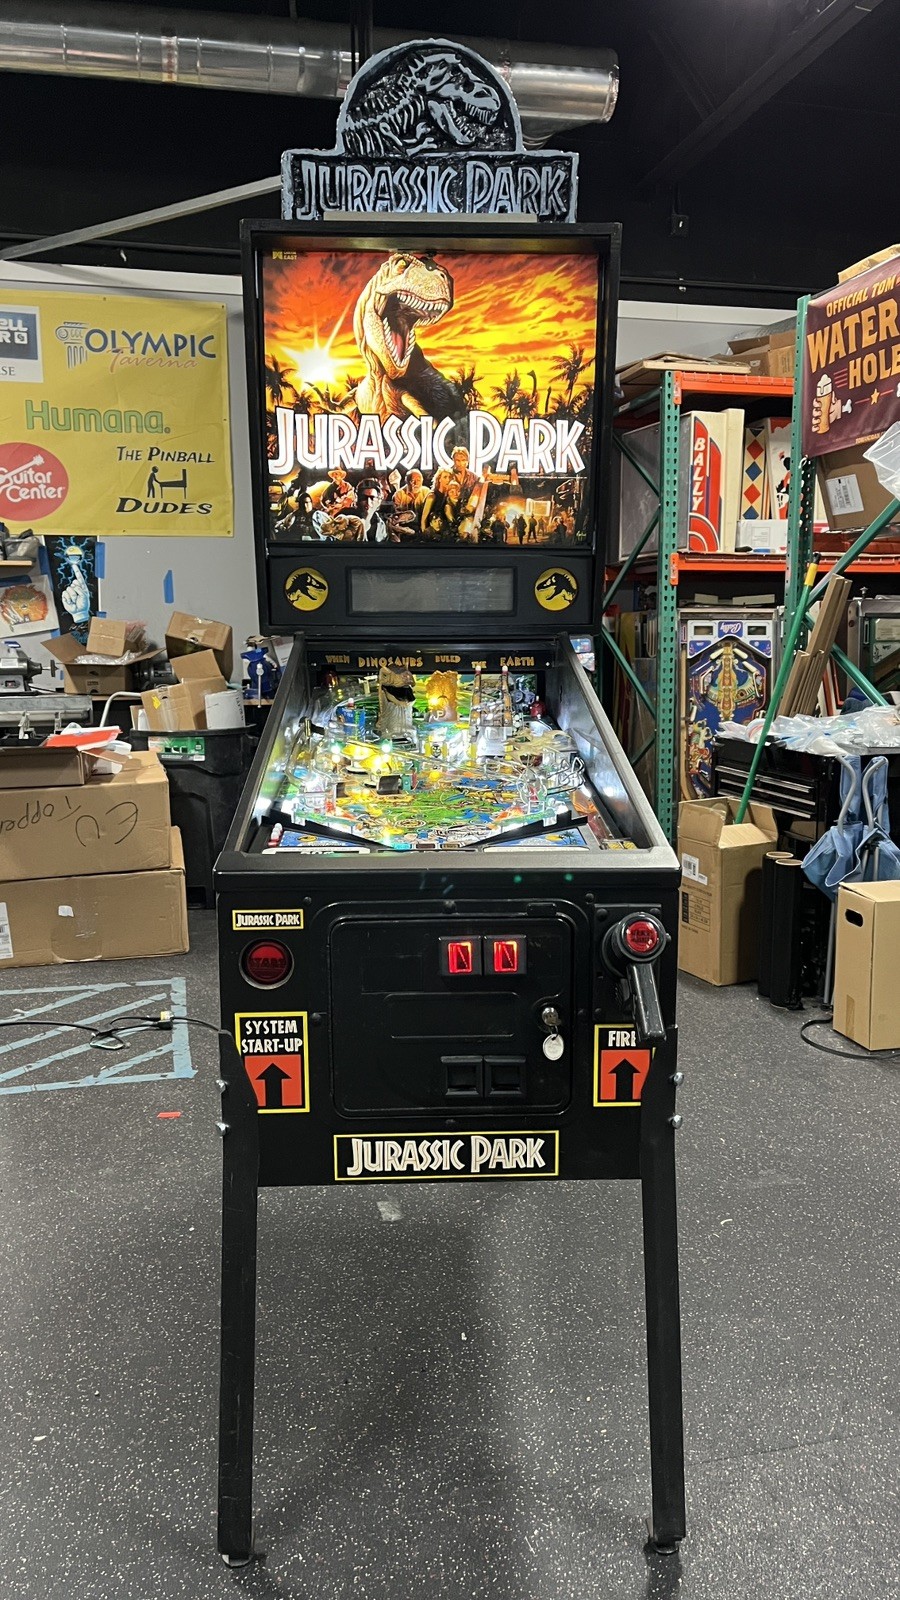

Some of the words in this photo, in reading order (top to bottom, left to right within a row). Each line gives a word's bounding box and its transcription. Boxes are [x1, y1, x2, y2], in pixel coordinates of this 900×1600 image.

[296, 160, 458, 220] JURASSIC
[466, 160, 568, 216] PARK
[826, 287, 869, 318] OFFICIAL
[871, 274, 897, 298] TOM
[84, 328, 217, 359] OLYMPIC
[807, 298, 900, 373] WATER
[106, 348, 199, 374] Taverna
[849, 344, 900, 389] HOLE
[268, 406, 456, 475] JURASSIC
[468, 410, 586, 474] PARK
[116, 446, 142, 462] THE
[147, 446, 215, 464] PINBALL
[692, 437, 706, 511] BALLY
[6, 483, 63, 503] Center
[116, 497, 213, 515] DUDES
[325, 655, 350, 664] WHEN
[358, 656, 424, 668] DINOSAURS
[500, 656, 535, 667] EARTH
[236, 913, 274, 927] JURASSIC
[275, 913, 300, 927] PARK
[245, 1019, 298, 1035] SYSTEM
[241, 1038, 303, 1054] START-UP
[346, 1137, 465, 1176] JURASSIC
[470, 1135, 546, 1173] PARK
